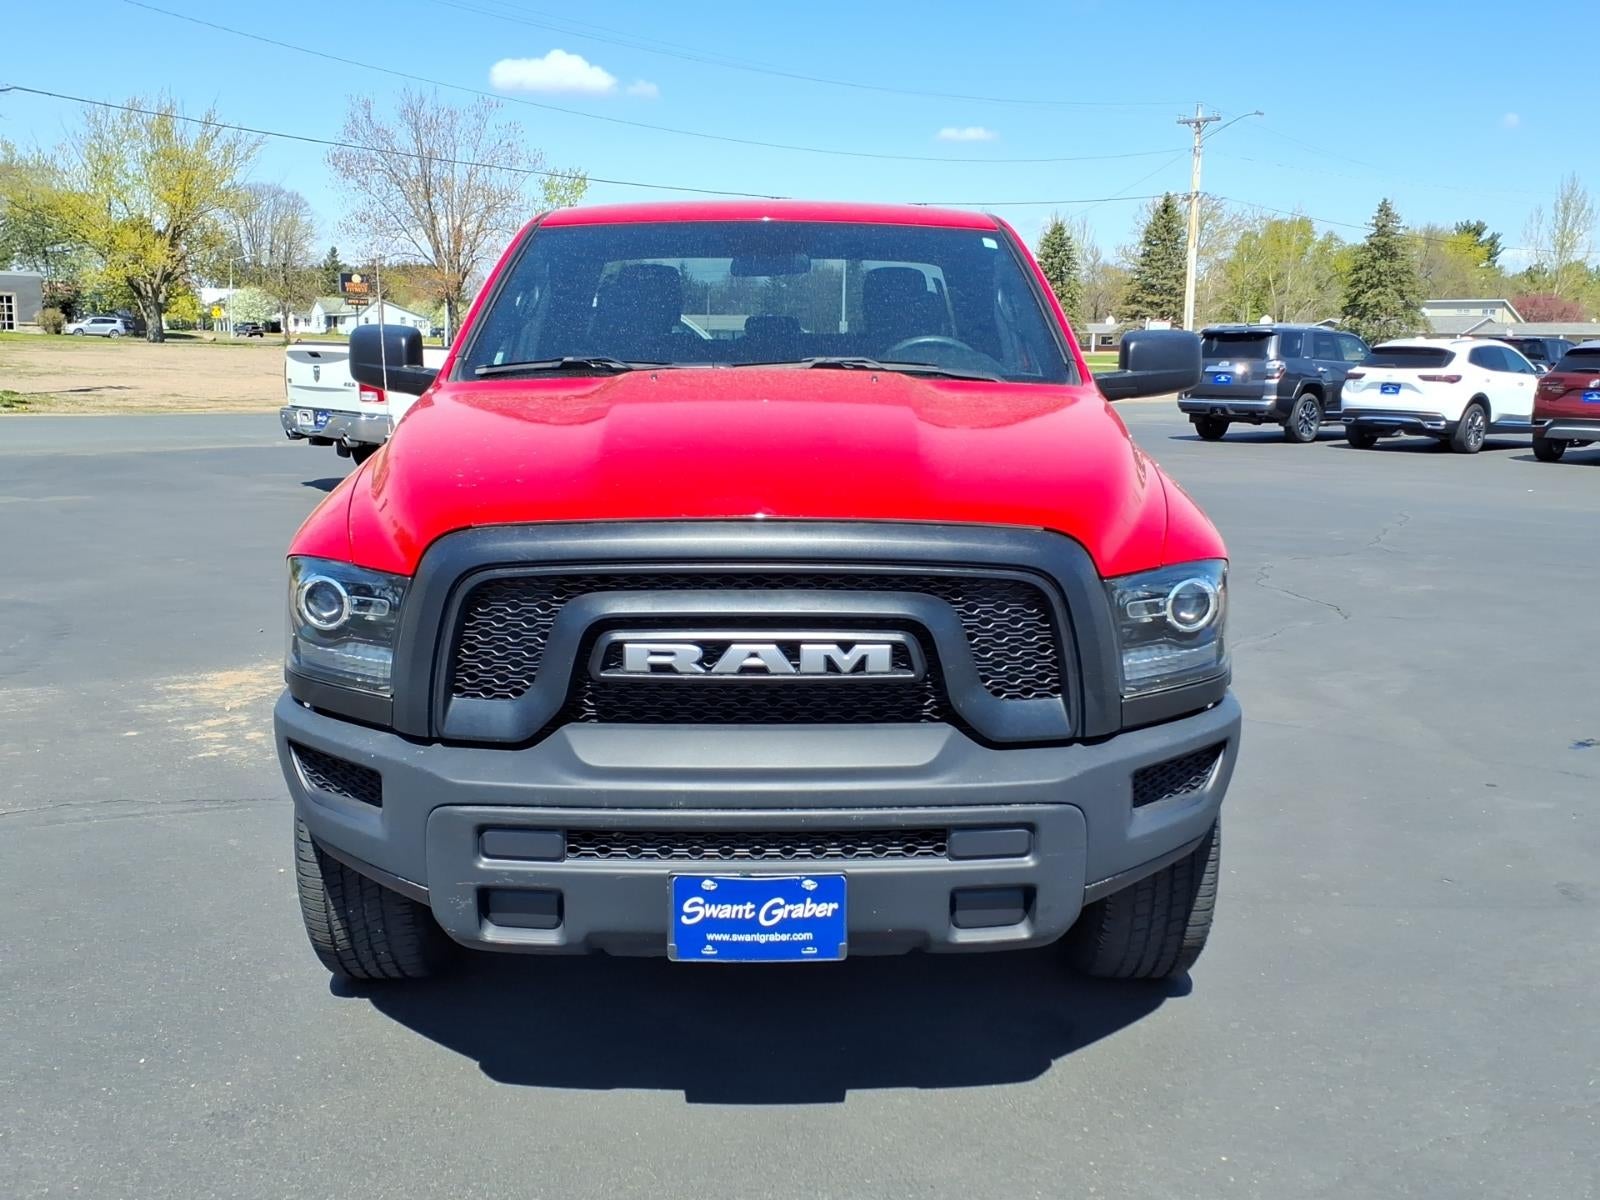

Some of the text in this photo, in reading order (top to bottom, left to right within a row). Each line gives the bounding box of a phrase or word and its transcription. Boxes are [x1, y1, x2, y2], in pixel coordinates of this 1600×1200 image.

[623, 643, 892, 674] RAM
[681, 896, 839, 927] Swant Graber
[706, 932, 813, 944] www.swantgraber.com
